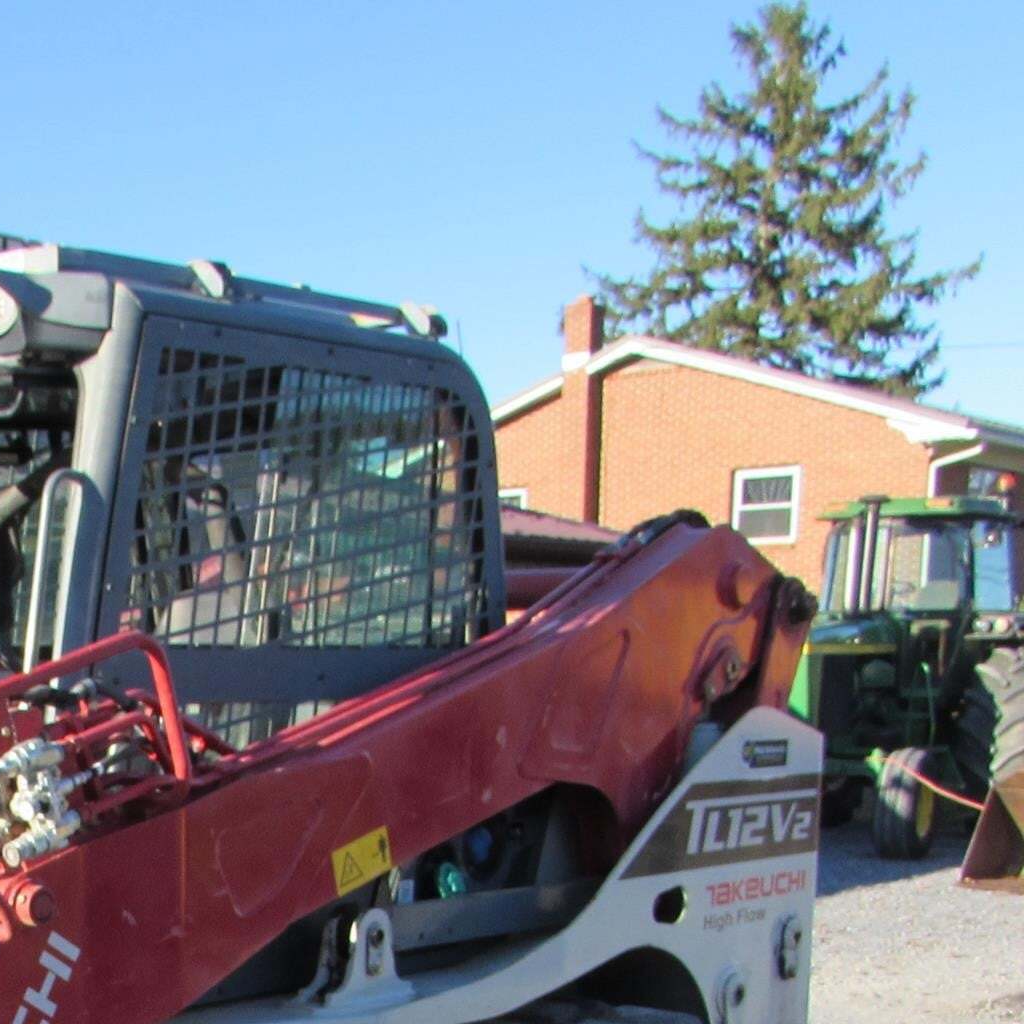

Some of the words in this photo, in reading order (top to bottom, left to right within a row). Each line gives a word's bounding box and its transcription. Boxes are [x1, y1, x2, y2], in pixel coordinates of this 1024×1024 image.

[685, 802, 812, 855] TL12V2
[703, 912, 733, 932] High
[736, 907, 767, 923] Flow
